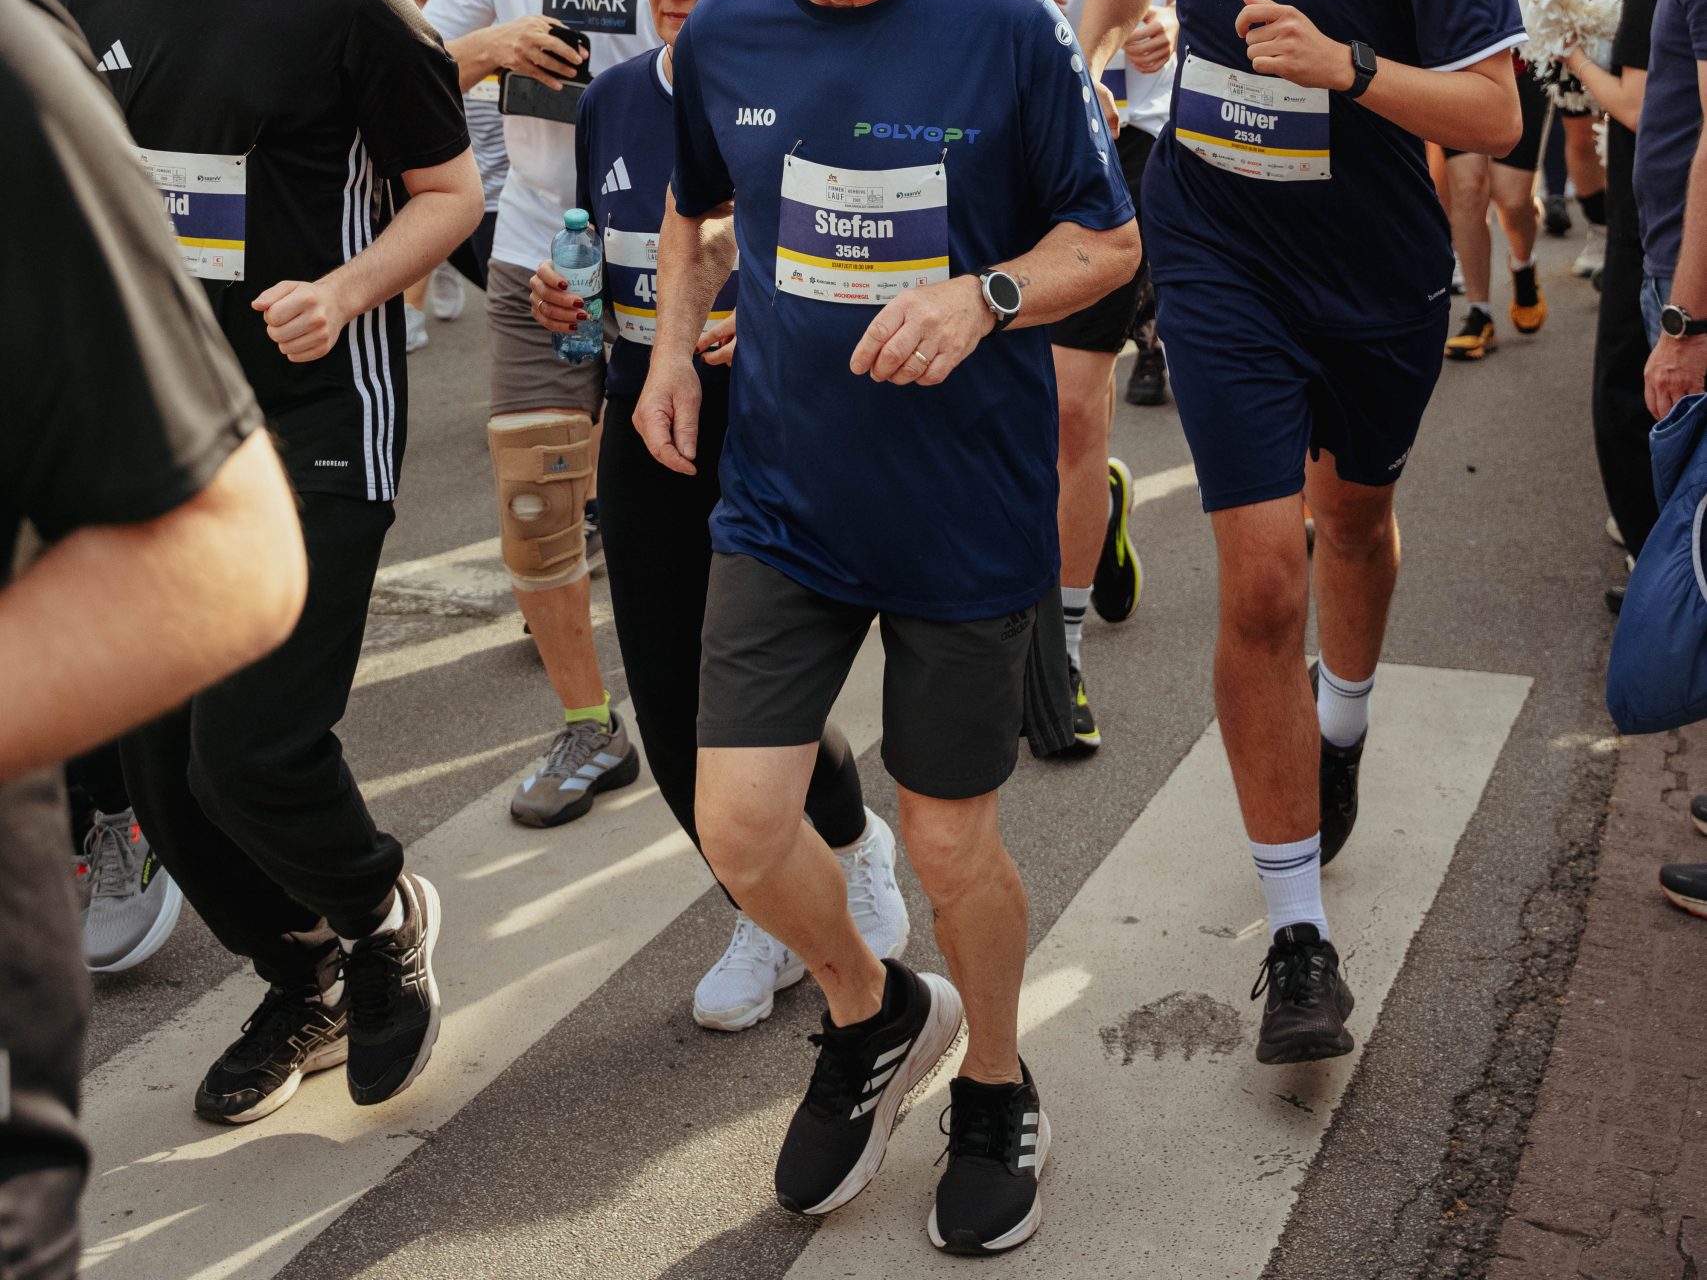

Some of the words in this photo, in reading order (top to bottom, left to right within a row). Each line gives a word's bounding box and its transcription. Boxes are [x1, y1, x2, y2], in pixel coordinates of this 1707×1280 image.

[735, 108, 776, 126] JAKO
[1221, 101, 1279, 130] Oliver
[854, 122, 981, 144] POLYOPT
[1234, 129, 1262, 144] 2534
[827, 192, 845, 201] LAUF
[815, 209, 894, 238] Stefan
[835, 244, 870, 259] 3564
[833, 292, 870, 300] WOCHENSPIEGEL
